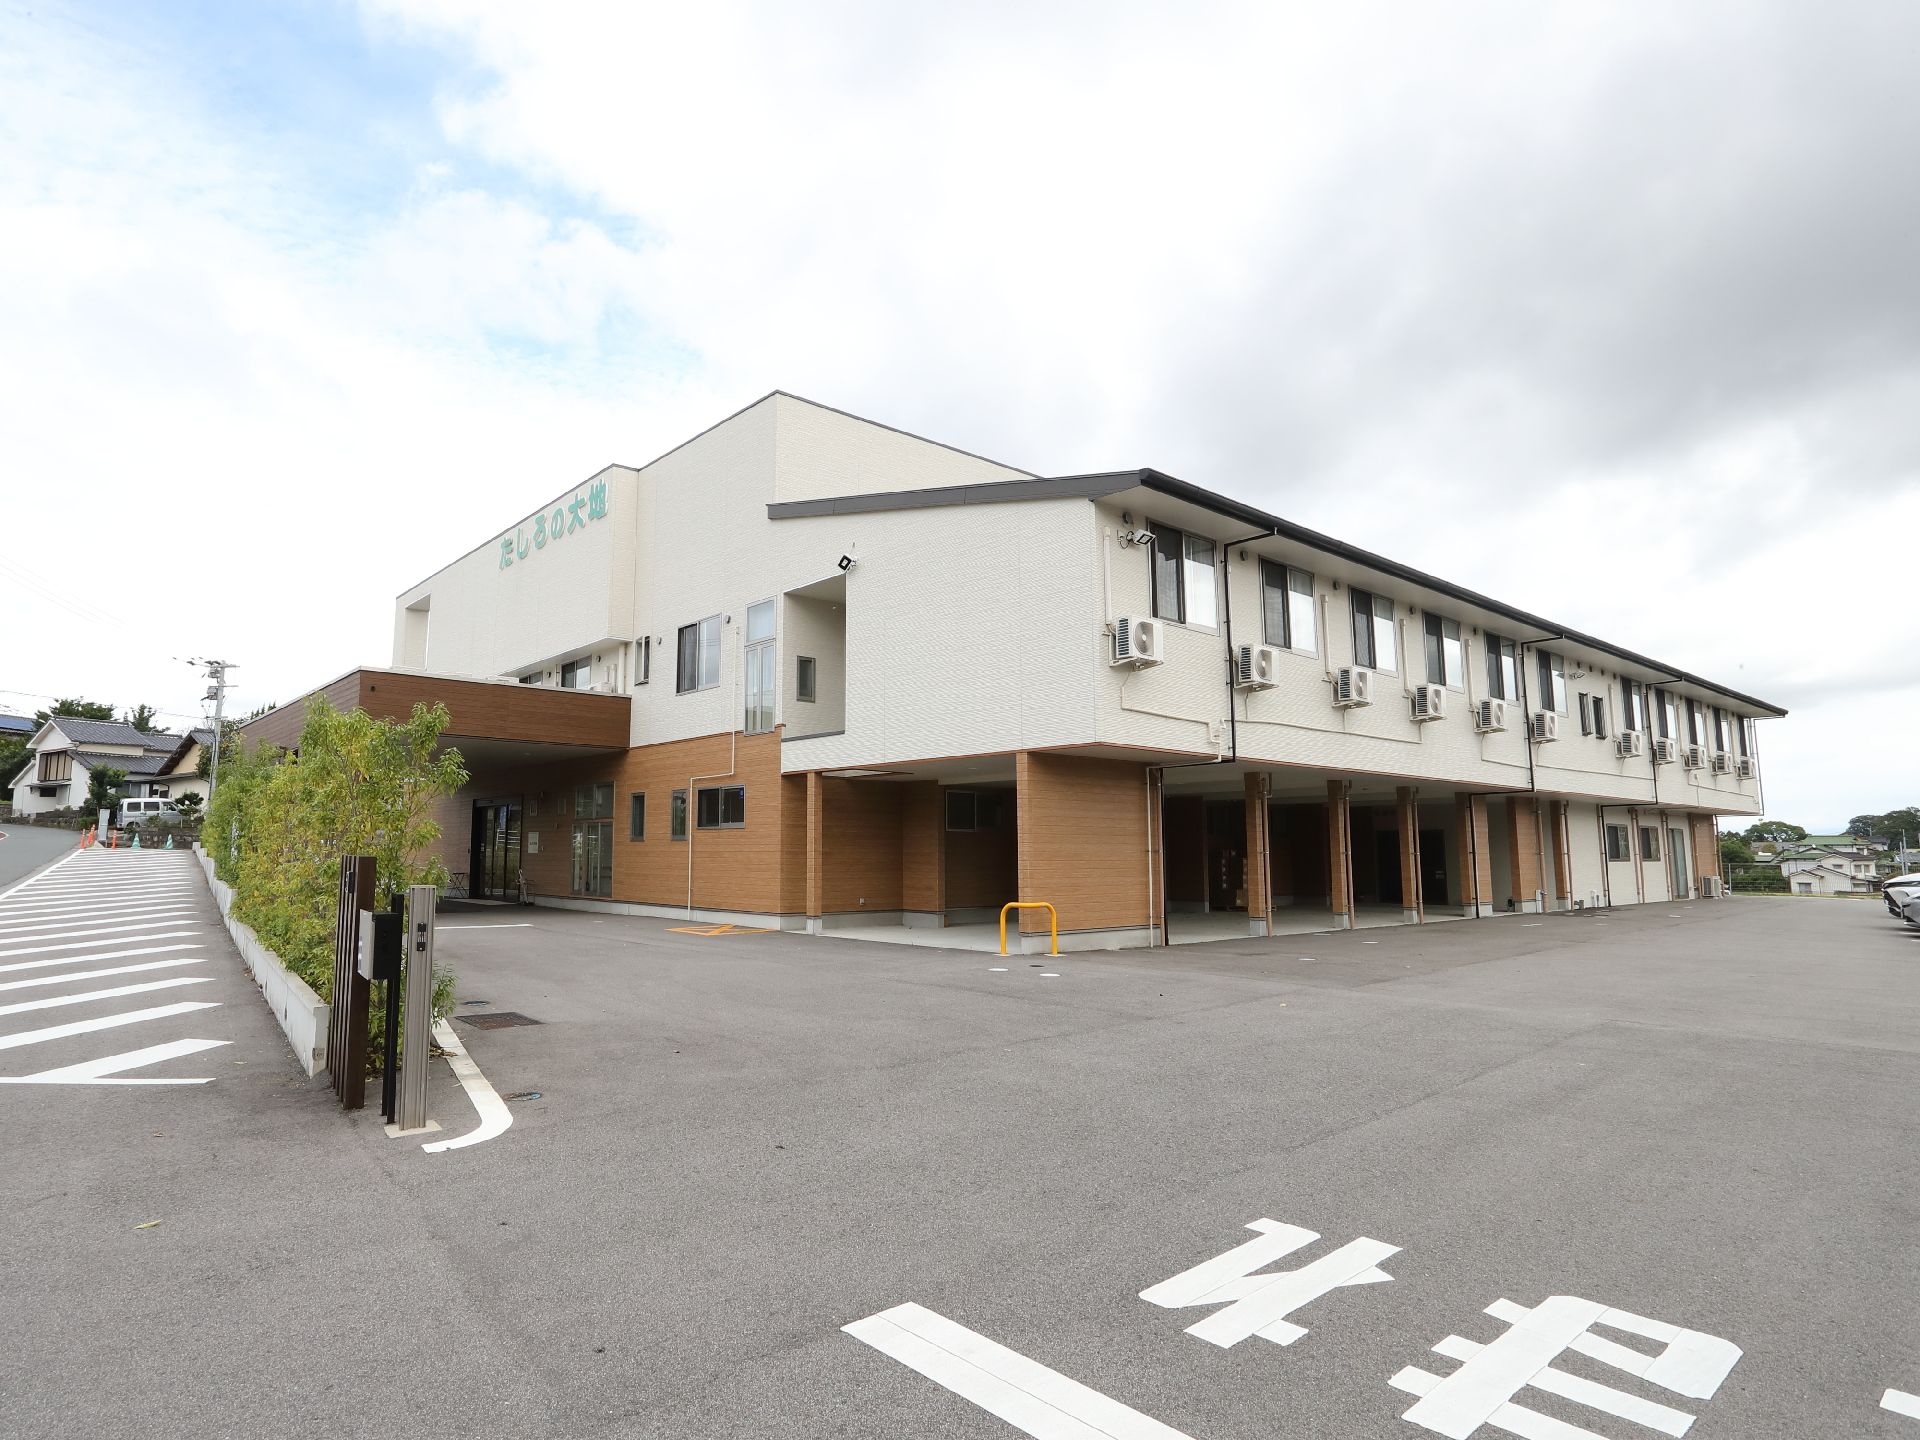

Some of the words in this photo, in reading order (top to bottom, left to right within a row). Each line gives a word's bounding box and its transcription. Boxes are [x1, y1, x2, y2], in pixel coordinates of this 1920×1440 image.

[499, 478, 608, 571] たしろの大地
[1138, 1217, 1920, 1440] まれ
